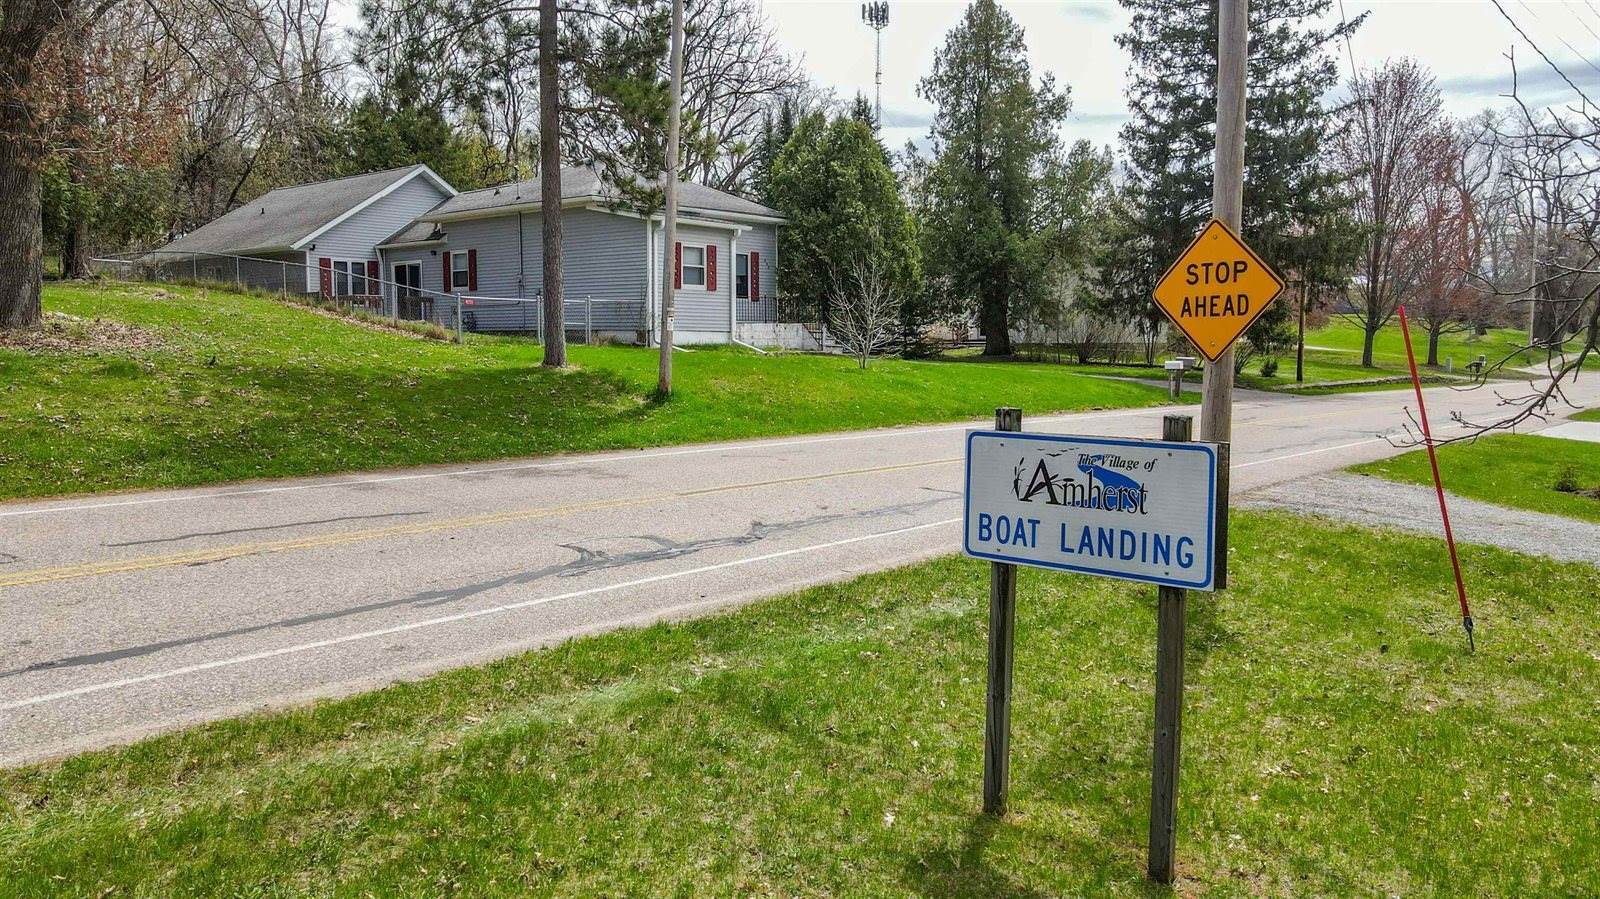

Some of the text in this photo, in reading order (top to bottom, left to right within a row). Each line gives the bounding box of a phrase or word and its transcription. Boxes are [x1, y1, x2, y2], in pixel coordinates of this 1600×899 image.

[1186, 260, 1248, 285] STOP
[1180, 294, 1249, 318] AHEAD
[1077, 453, 1158, 472] The Village of
[1019, 458, 1148, 515] Amherst
[978, 512, 1194, 569] BOAT LANDING
